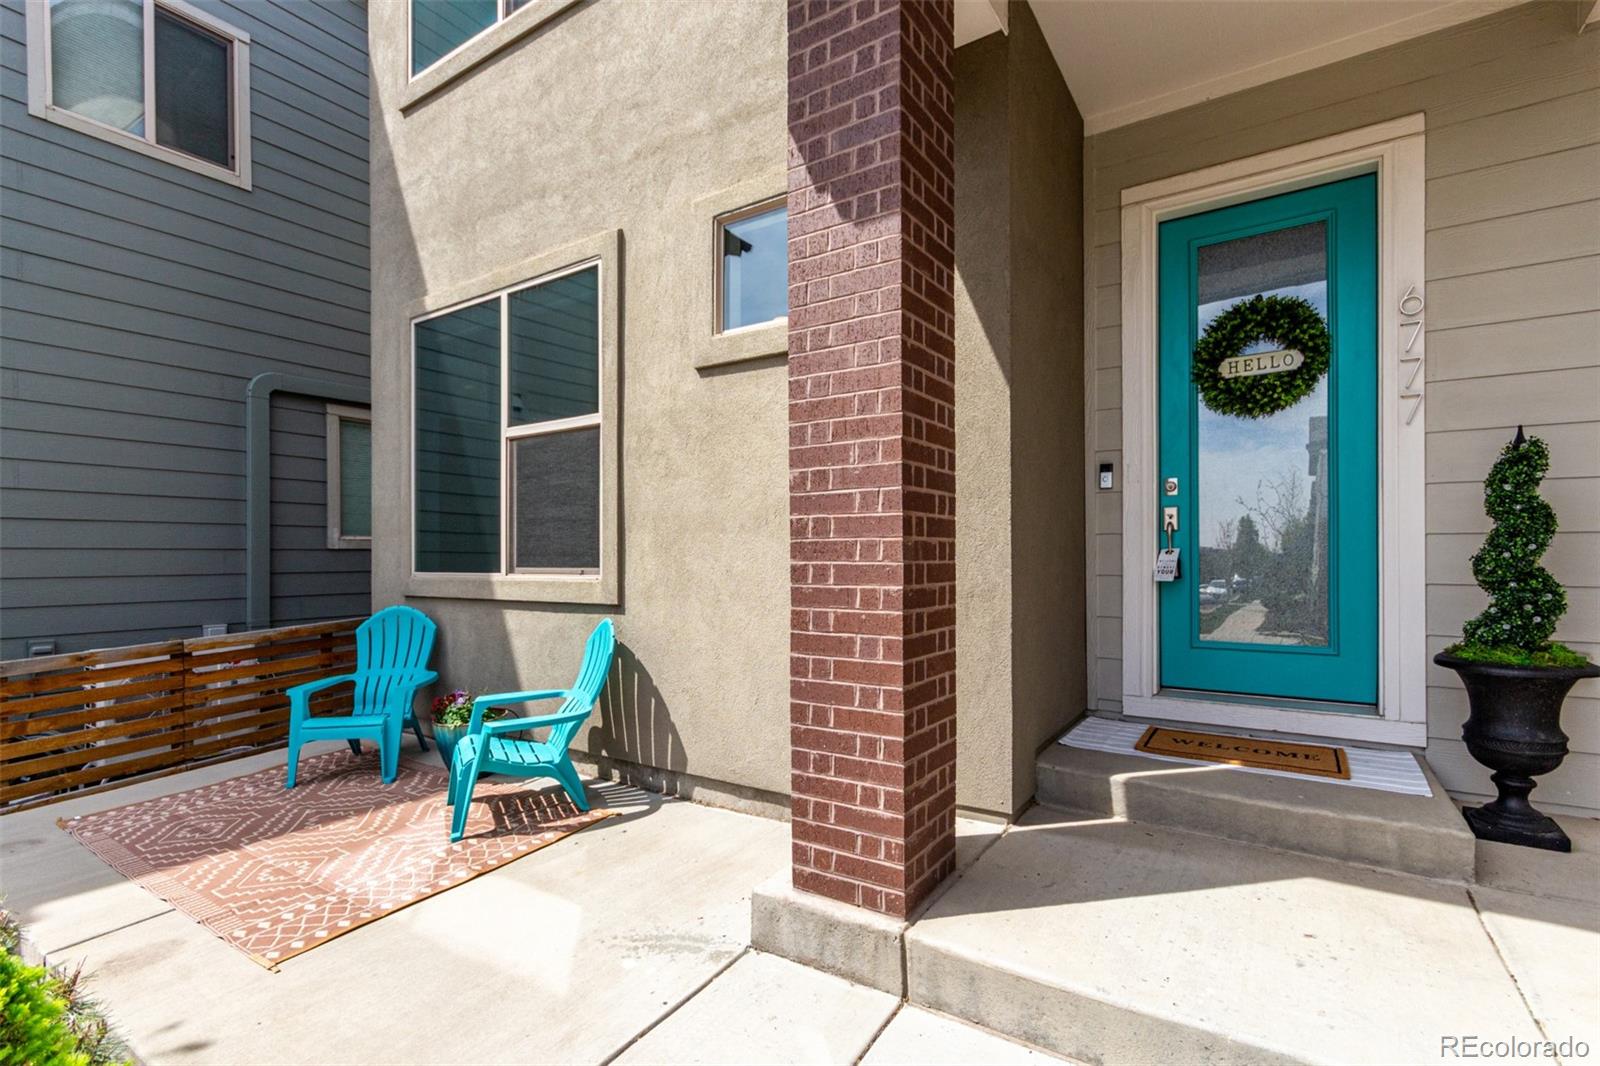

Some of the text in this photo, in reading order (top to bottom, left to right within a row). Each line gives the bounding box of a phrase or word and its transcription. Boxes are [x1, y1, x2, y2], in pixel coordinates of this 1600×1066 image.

[1228, 353, 1295, 374] HELLO
[1399, 285, 1425, 426] 6777
[1171, 737, 1321, 762] WELCOME
